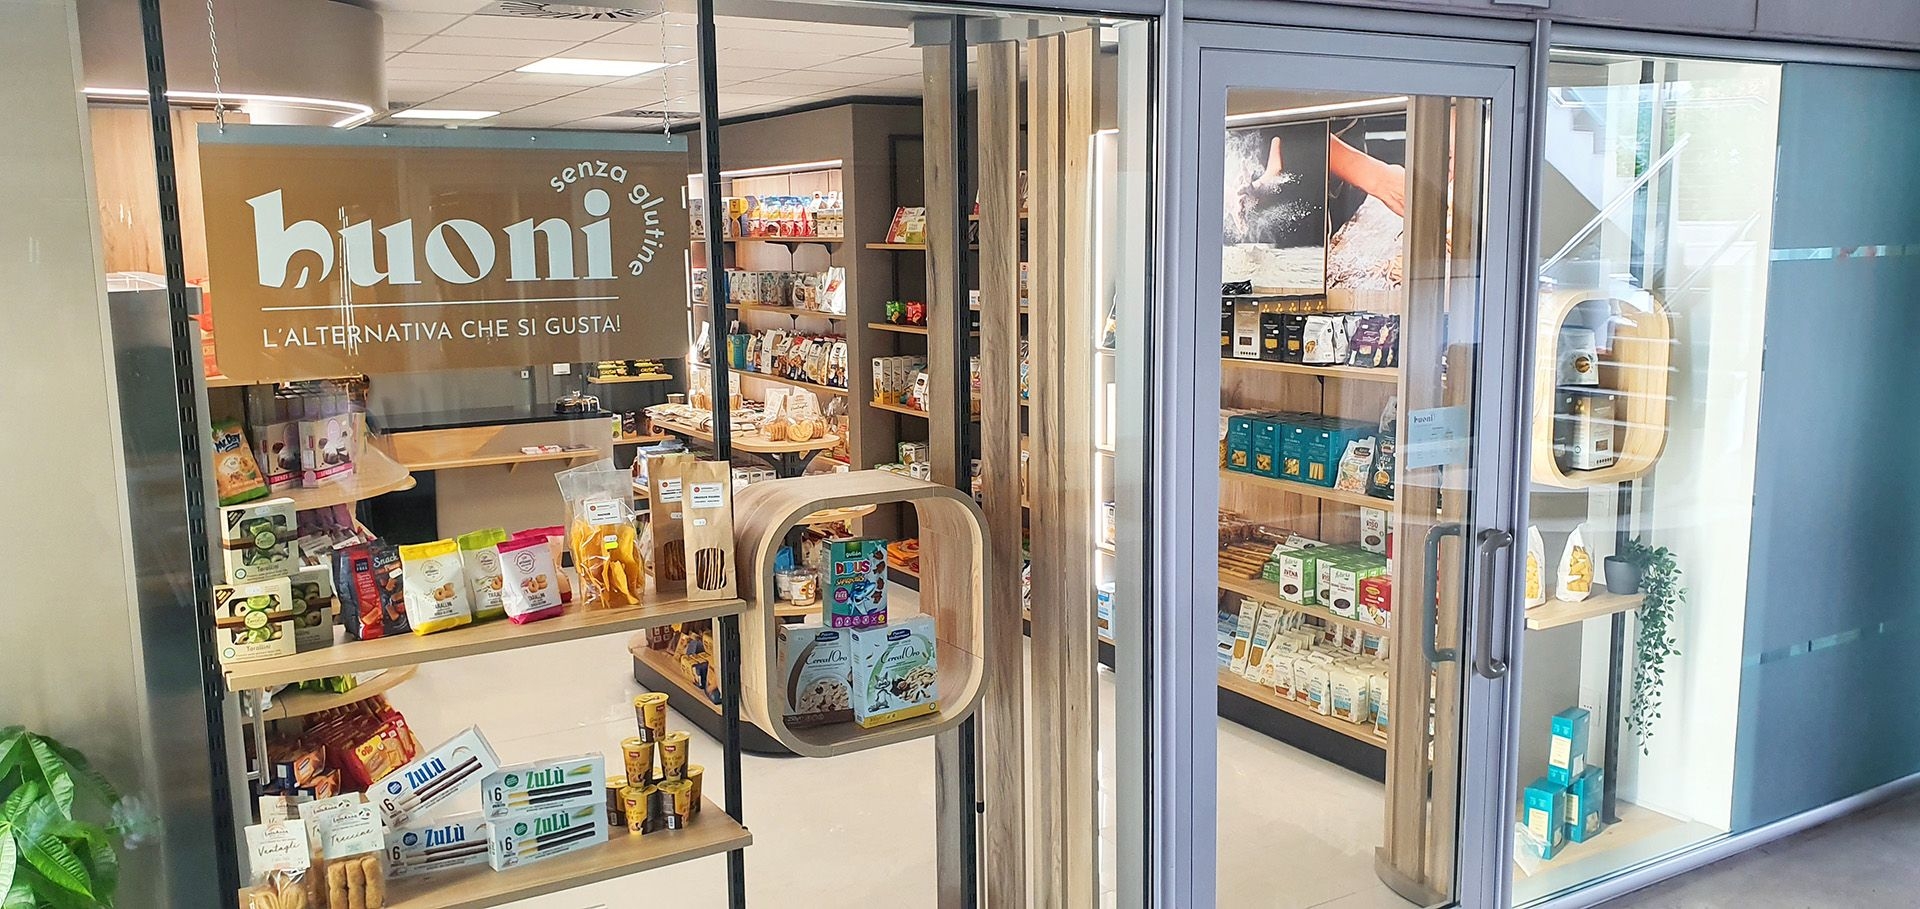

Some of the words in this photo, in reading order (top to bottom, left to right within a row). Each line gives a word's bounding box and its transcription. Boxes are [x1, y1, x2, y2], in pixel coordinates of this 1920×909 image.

[550, 159, 628, 193] senza
[627, 182, 667, 278] glutine
[245, 188, 619, 289] buoni
[461, 319, 509, 339] CHE
[518, 316, 537, 337] SI
[545, 313, 622, 336] GUSTA!
[373, 552, 399, 568] Snack
[835, 559, 871, 575] DIBUS
[494, 787, 503, 802] 6
[383, 798, 395, 812] 6
[505, 836, 513, 851] 6
[392, 845, 401, 860] 6
